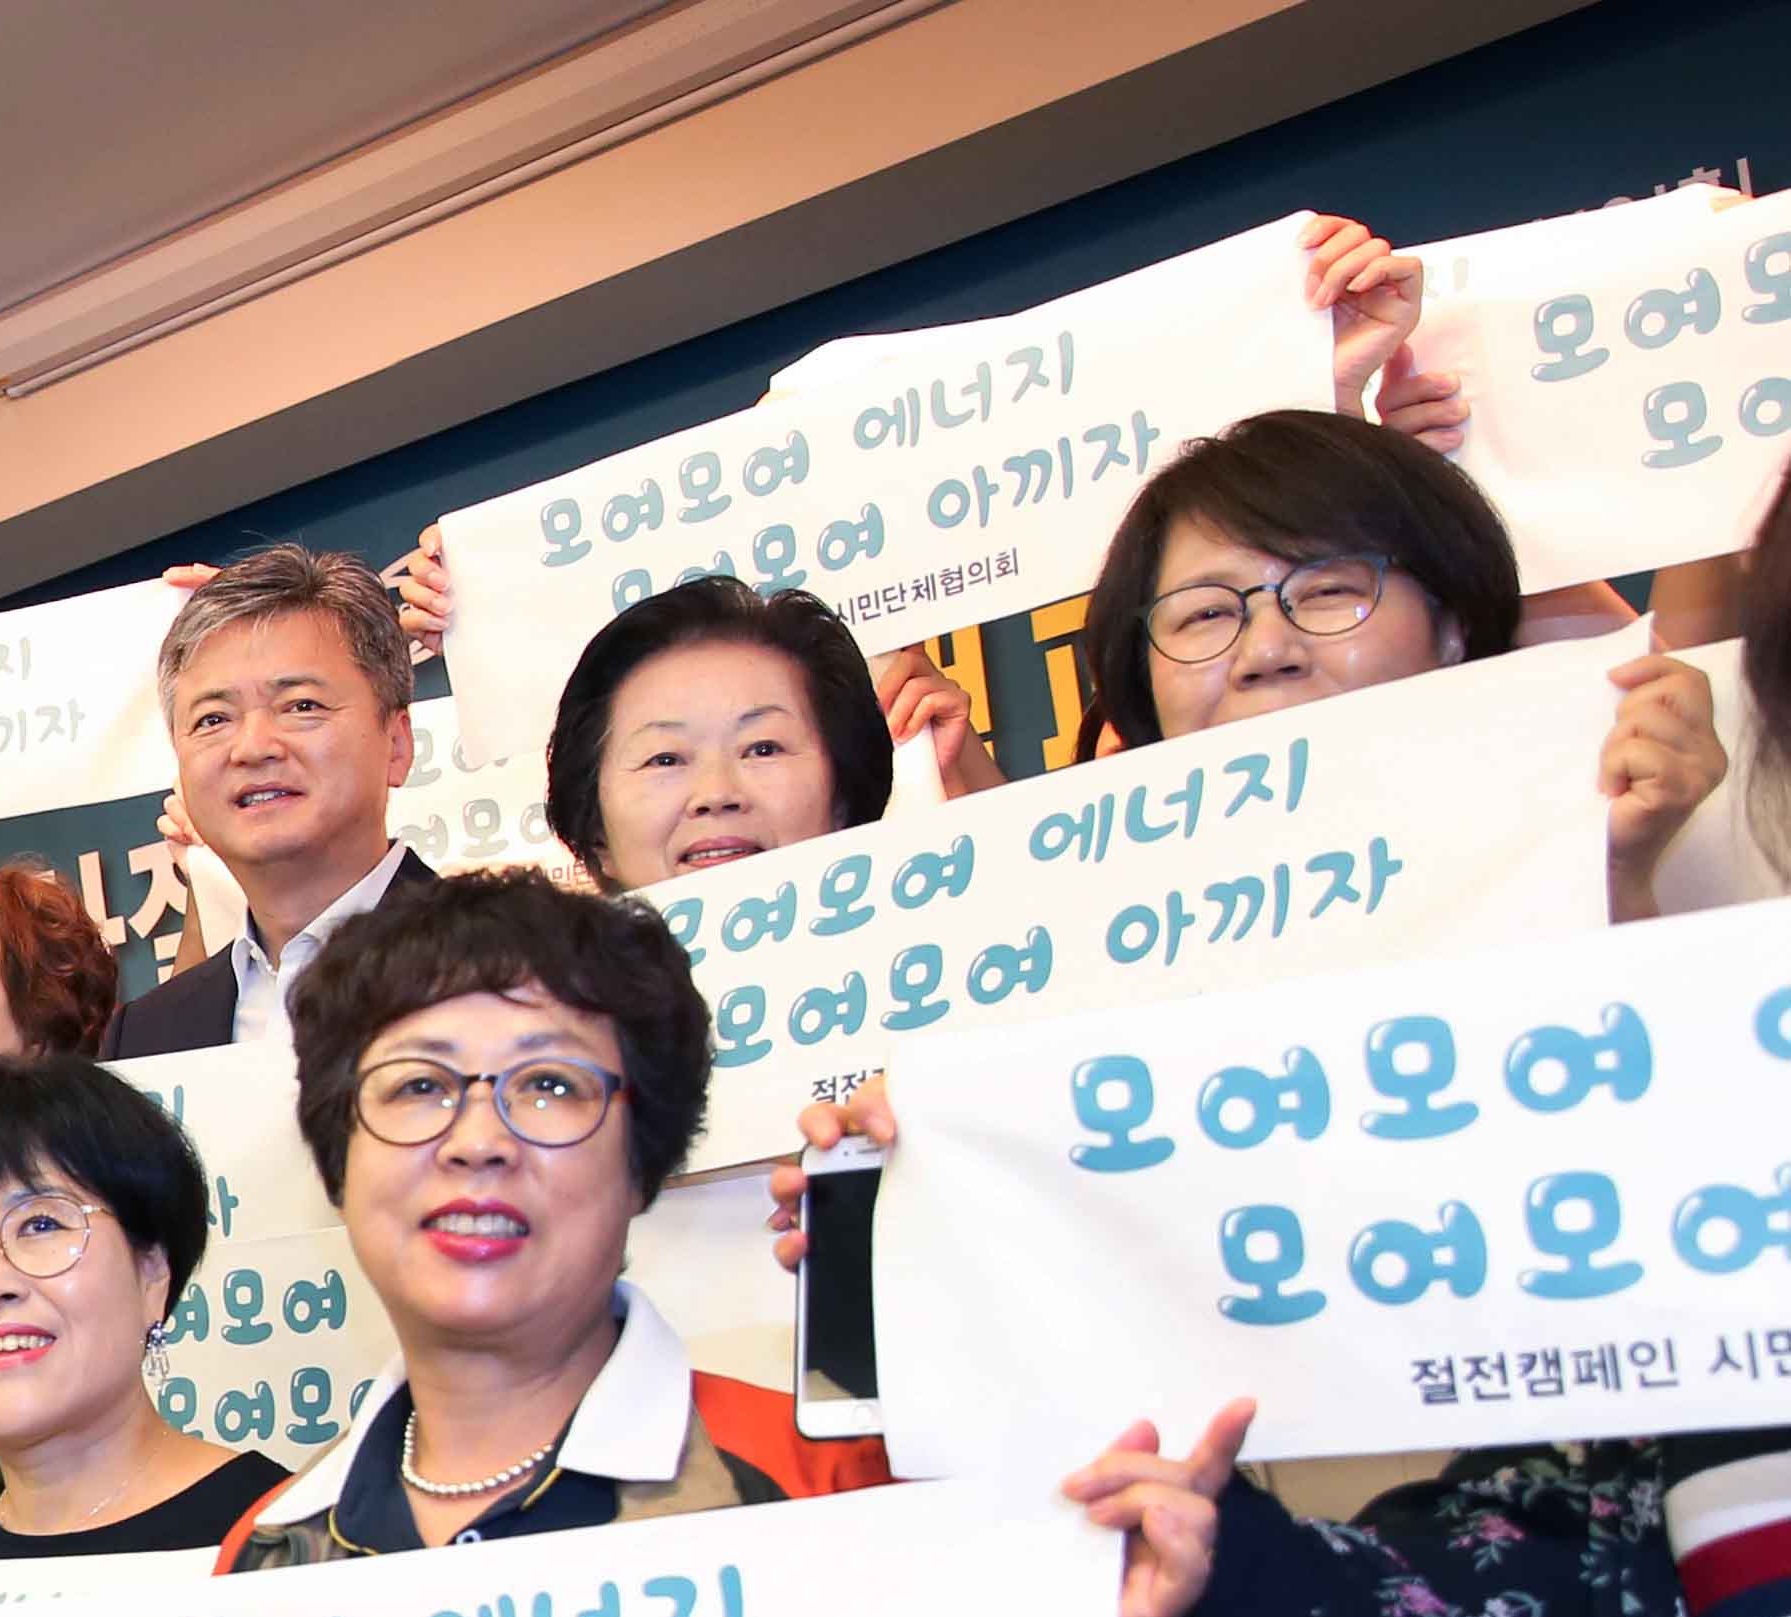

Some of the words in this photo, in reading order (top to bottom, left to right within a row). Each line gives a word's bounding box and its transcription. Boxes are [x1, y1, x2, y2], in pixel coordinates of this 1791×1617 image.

[539, 429, 810, 568] 모여모여
[851, 330, 1074, 455] 에너지
[612, 503, 885, 612] 모모여
[927, 410, 1161, 531] 아끼자
[838, 548, 1021, 627] 시민단체협의회
[661, 834, 975, 968] 모여모여
[1028, 739, 1308, 866] 에너지
[712, 924, 1055, 1068] 모여모여
[1106, 837, 1403, 966] 아끼자
[1069, 1003, 1654, 1174] 모여모여
[164, 1269, 347, 1345] 여모여
[1217, 1163, 1791, 1327] 모여모여
[1412, 1338, 1678, 1405] 절전캠페인
